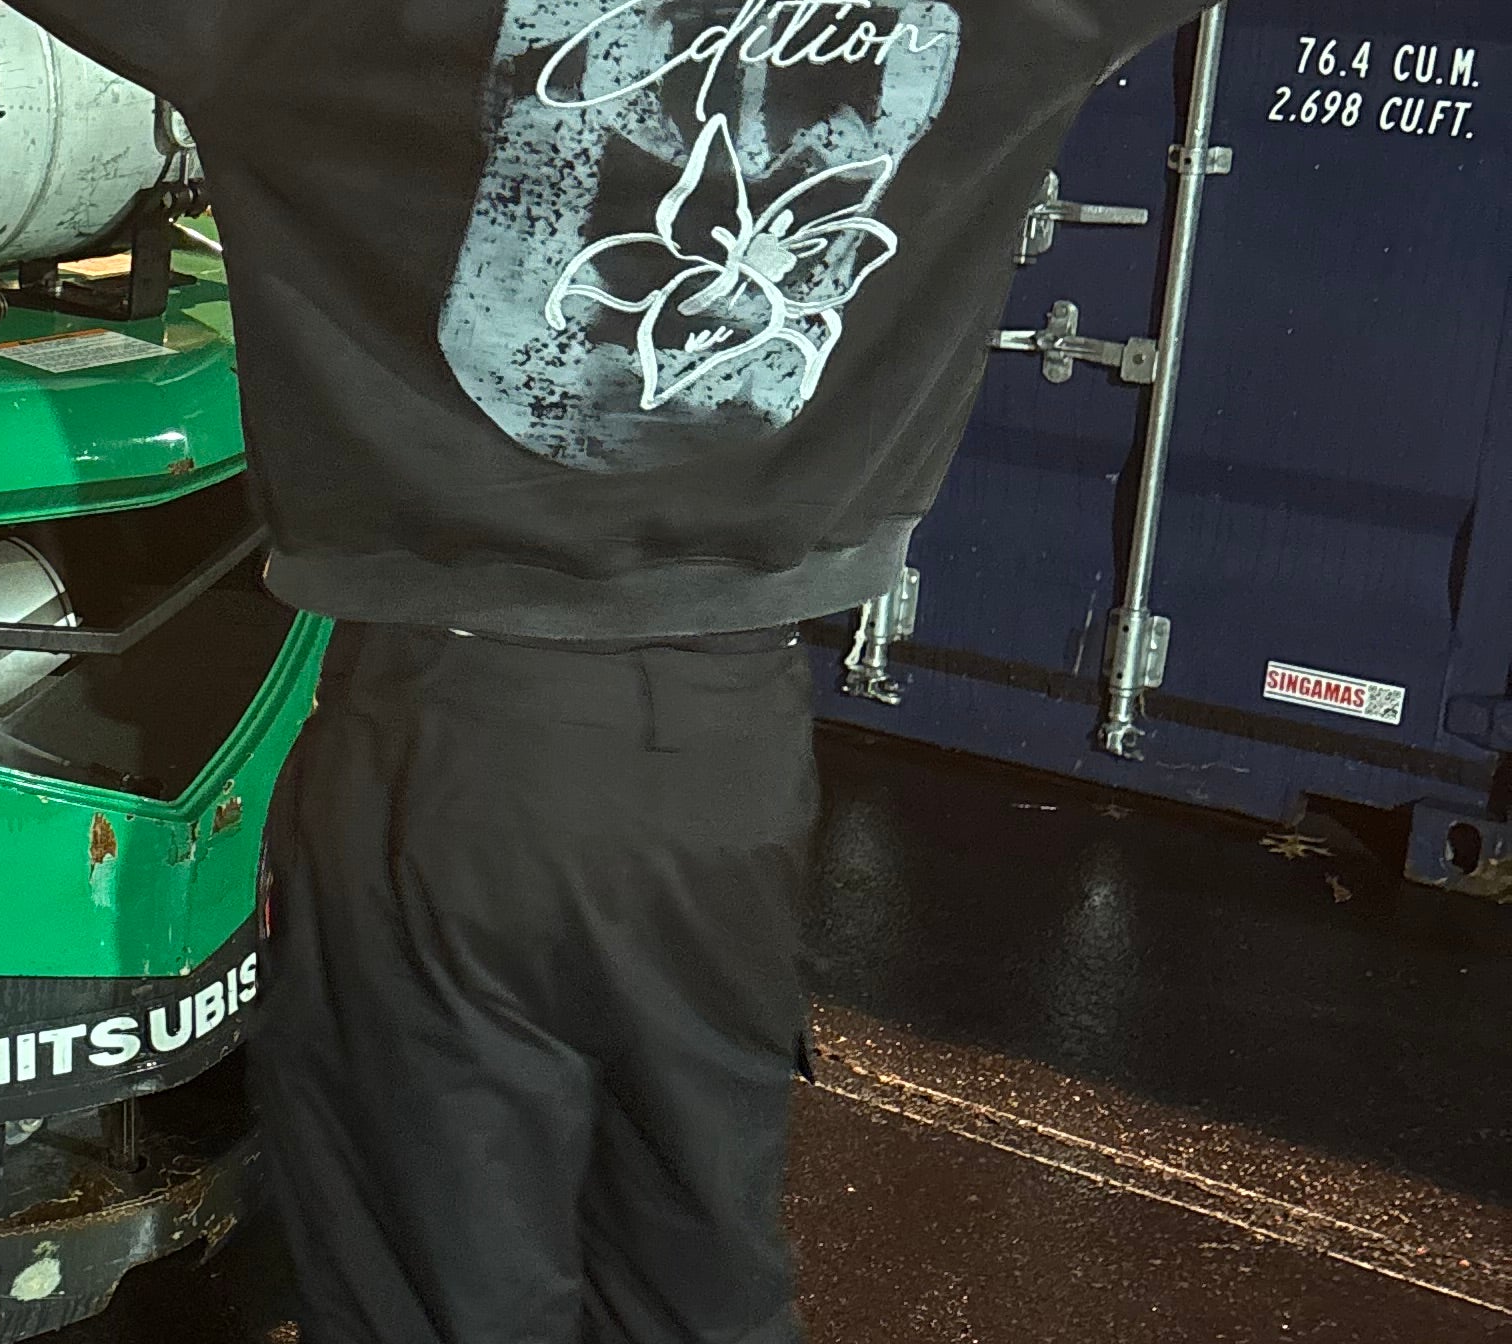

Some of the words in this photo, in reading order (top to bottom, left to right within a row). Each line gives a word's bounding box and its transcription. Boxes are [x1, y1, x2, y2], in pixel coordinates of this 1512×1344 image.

[1296, 36, 1372, 79] 76.4
[1393, 44, 1480, 88] CU.M.
[1268, 86, 1363, 127] 2.698
[1379, 96, 1474, 139] CU.FT.
[1266, 669, 1366, 708] SINGAMAS
